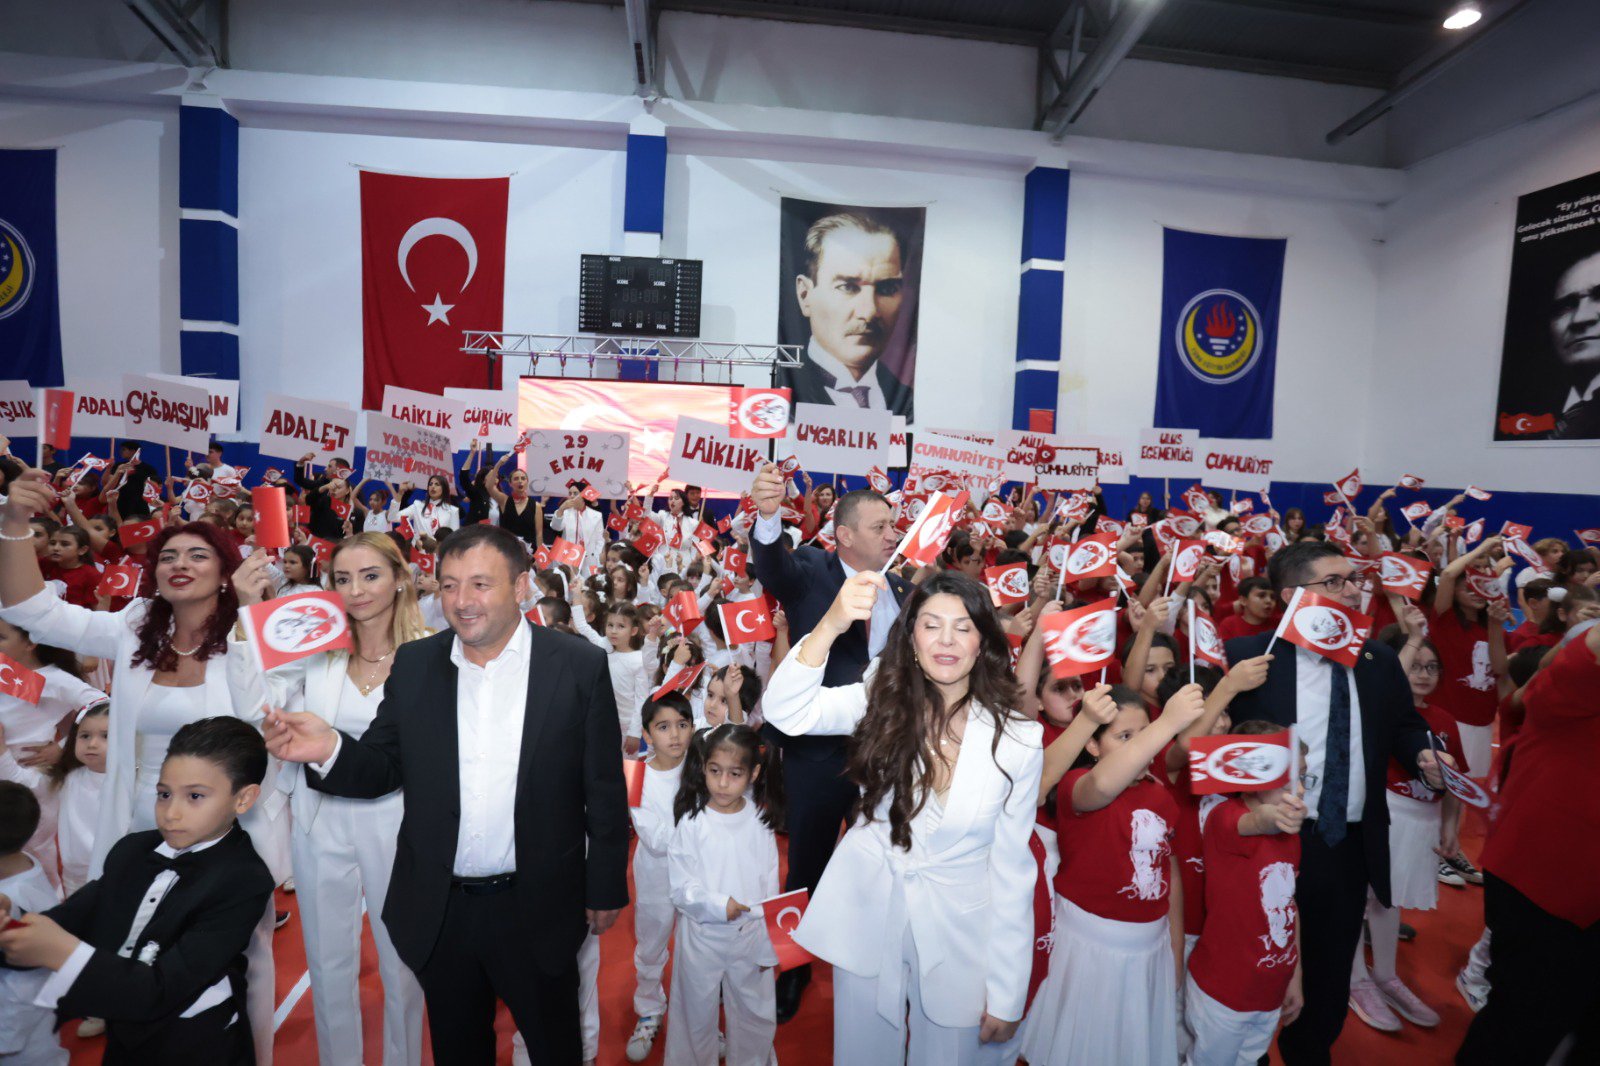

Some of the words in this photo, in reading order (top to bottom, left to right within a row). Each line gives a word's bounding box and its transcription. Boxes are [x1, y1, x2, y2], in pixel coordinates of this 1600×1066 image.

[0, 400, 36, 422] ŞLIK
[391, 404, 453, 430] LAİKLİK
[265, 409, 349, 448] ADALET
[563, 434, 589, 449] 29
[796, 423, 878, 450] UYGARLIK
[1159, 433, 1183, 445] ULUS
[549, 451, 605, 475] EKİM
[681, 432, 759, 472] LAİKLİK
[914, 442, 1005, 471] CUMHURİYET
[1206, 452, 1273, 475] CUMHURİYET
[1034, 462, 1099, 477] CUMHURİYET
[1348, 628, 1369, 656] ATA
[1189, 750, 1209, 782] ATA
